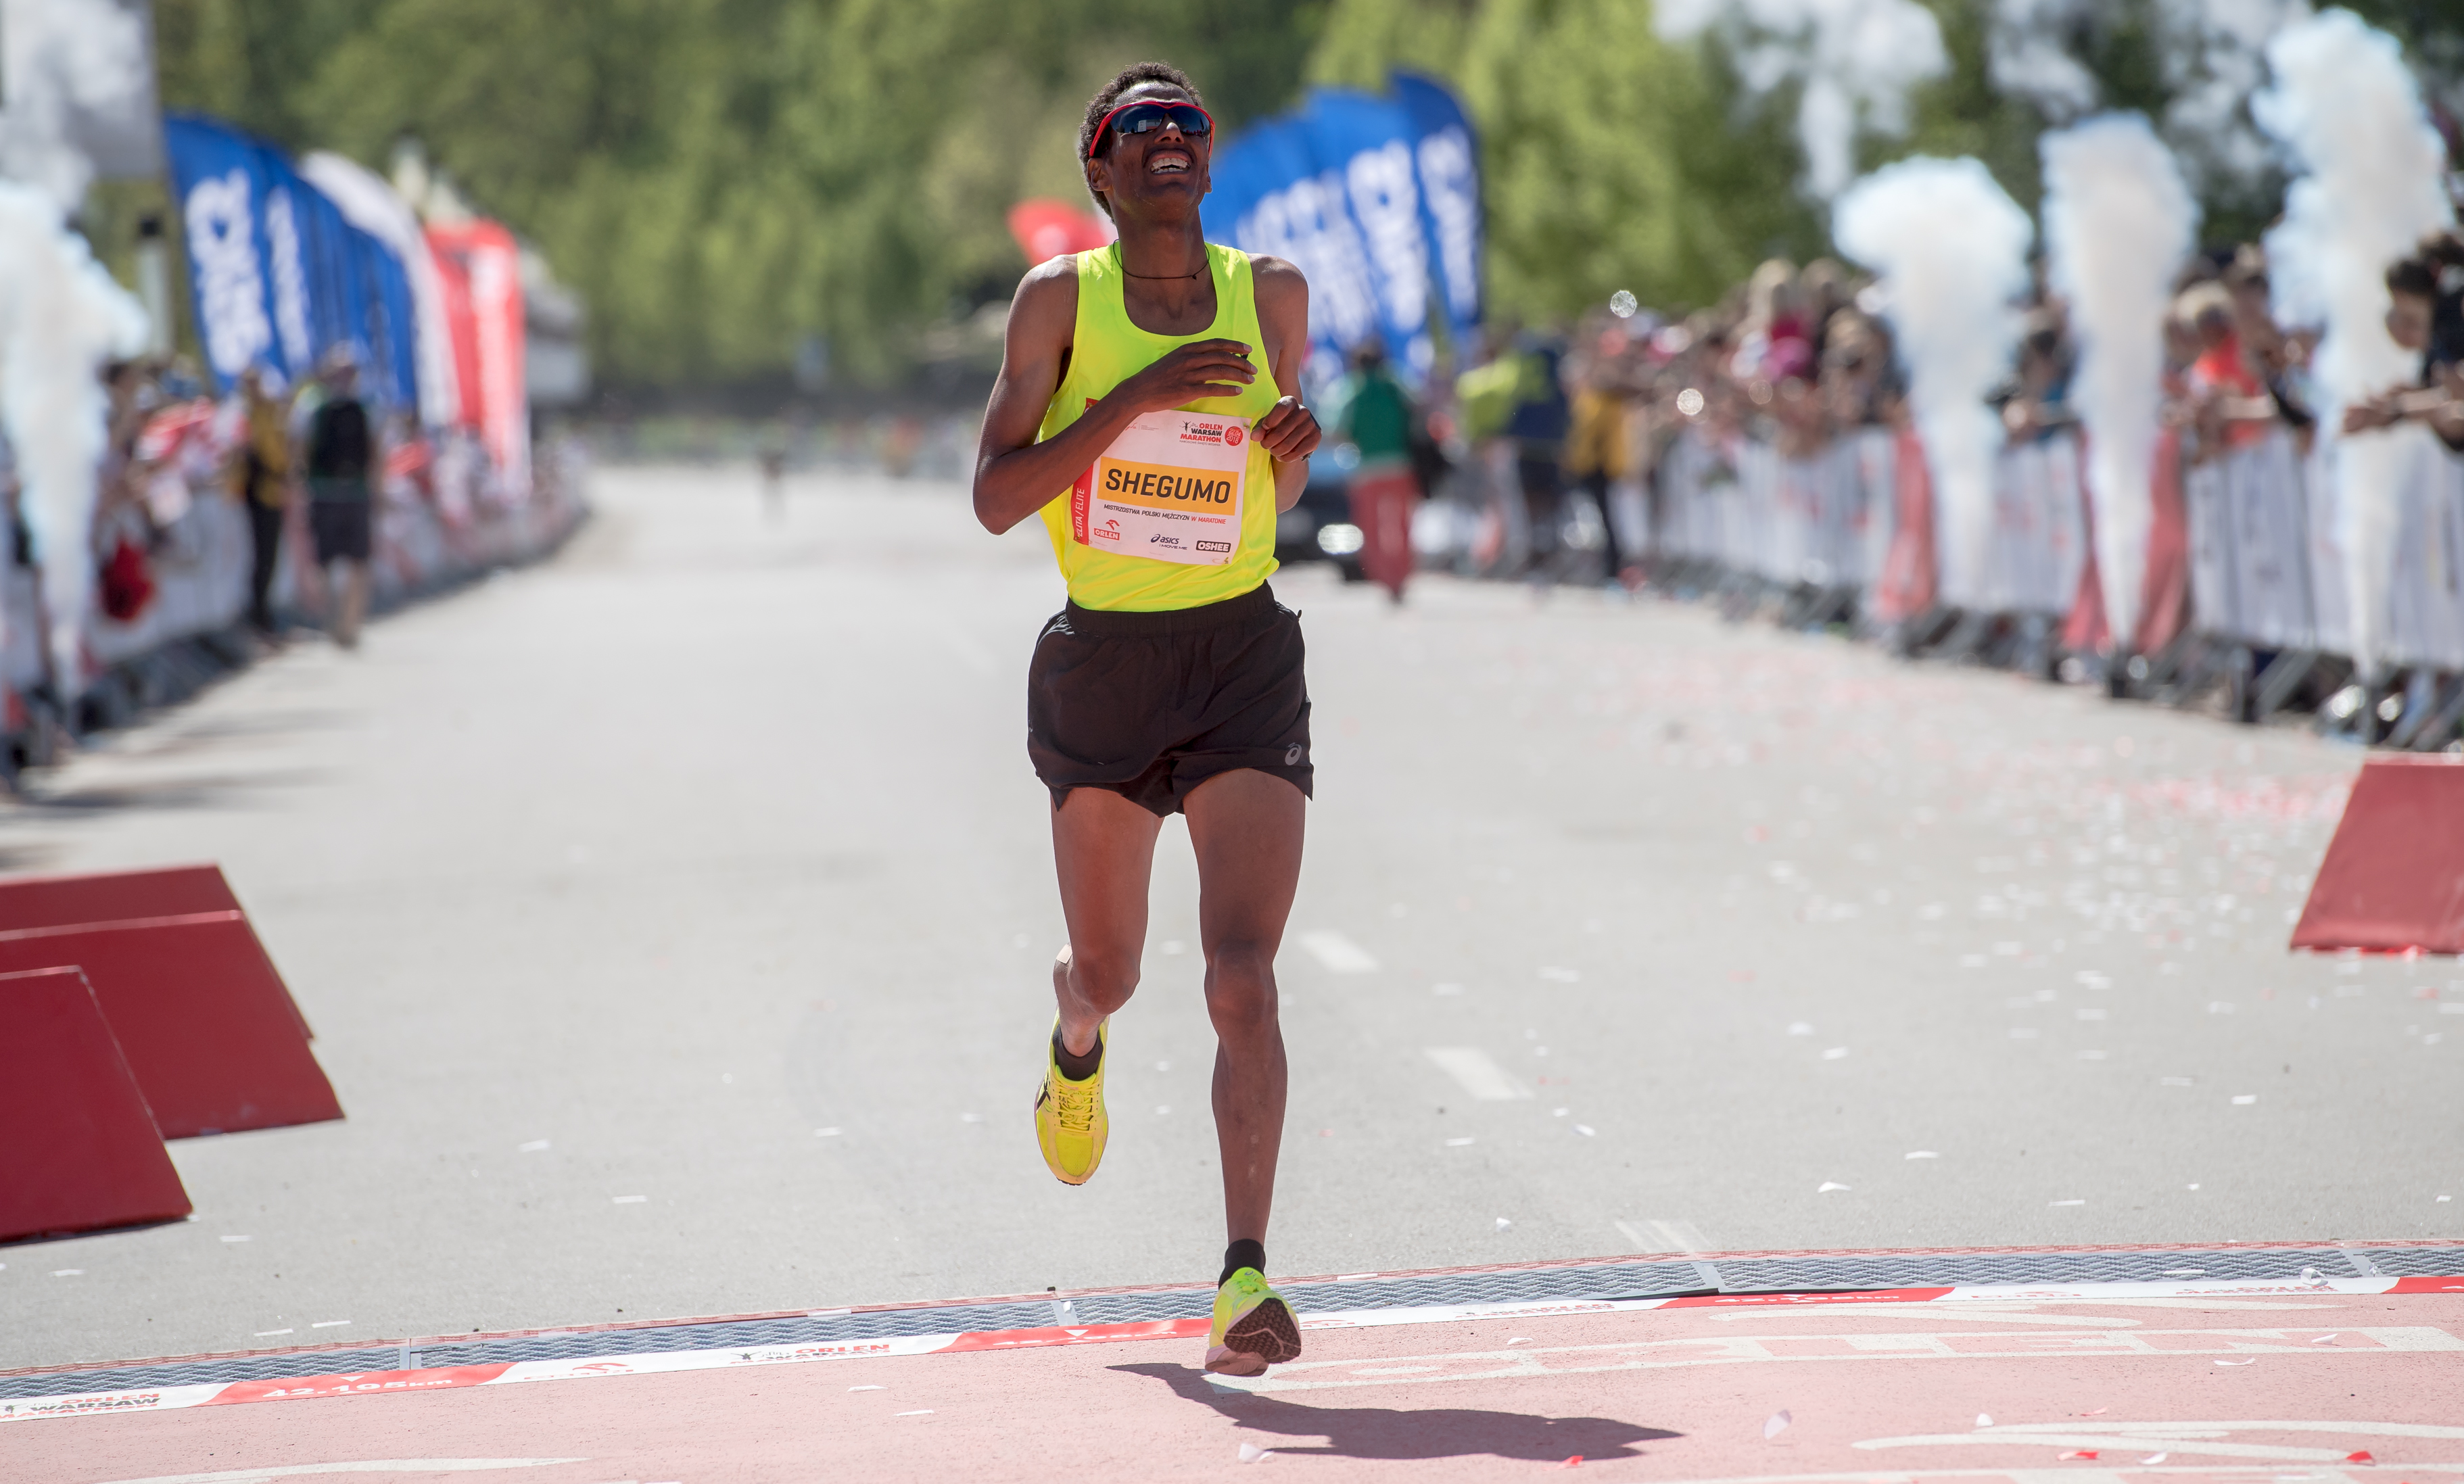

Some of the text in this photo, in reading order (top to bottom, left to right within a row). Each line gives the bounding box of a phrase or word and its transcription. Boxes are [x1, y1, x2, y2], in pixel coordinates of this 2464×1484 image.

[1191, 428, 1223, 436] WARSAW
[1199, 423, 1223, 431] ORLEN
[1229, 427, 1241, 437] 22.04
[1180, 433, 1221, 443] MARATHON
[1226, 434, 1239, 444] 2018
[1106, 468, 1231, 504] SHEGUMO
[1075, 487, 1085, 510] ELITE
[1104, 504, 1140, 515] MISTRZOSTWA
[1141, 510, 1161, 518] POLSKI
[1162, 512, 1190, 521] MĘŻCZYZN
[1198, 517, 1227, 525] MARATONIE
[1075, 516, 1083, 537] ELITA
[1095, 529, 1118, 540] ORLEN
[1160, 536, 1179, 545] asics
[1198, 542, 1230, 552] OSHEE
[795, 1344, 889, 1354] ORLEN
[262, 1379, 452, 1397] 42.195km
[61, 1393, 160, 1404] ORLEN
[29, 1397, 161, 1412] WARSAW
